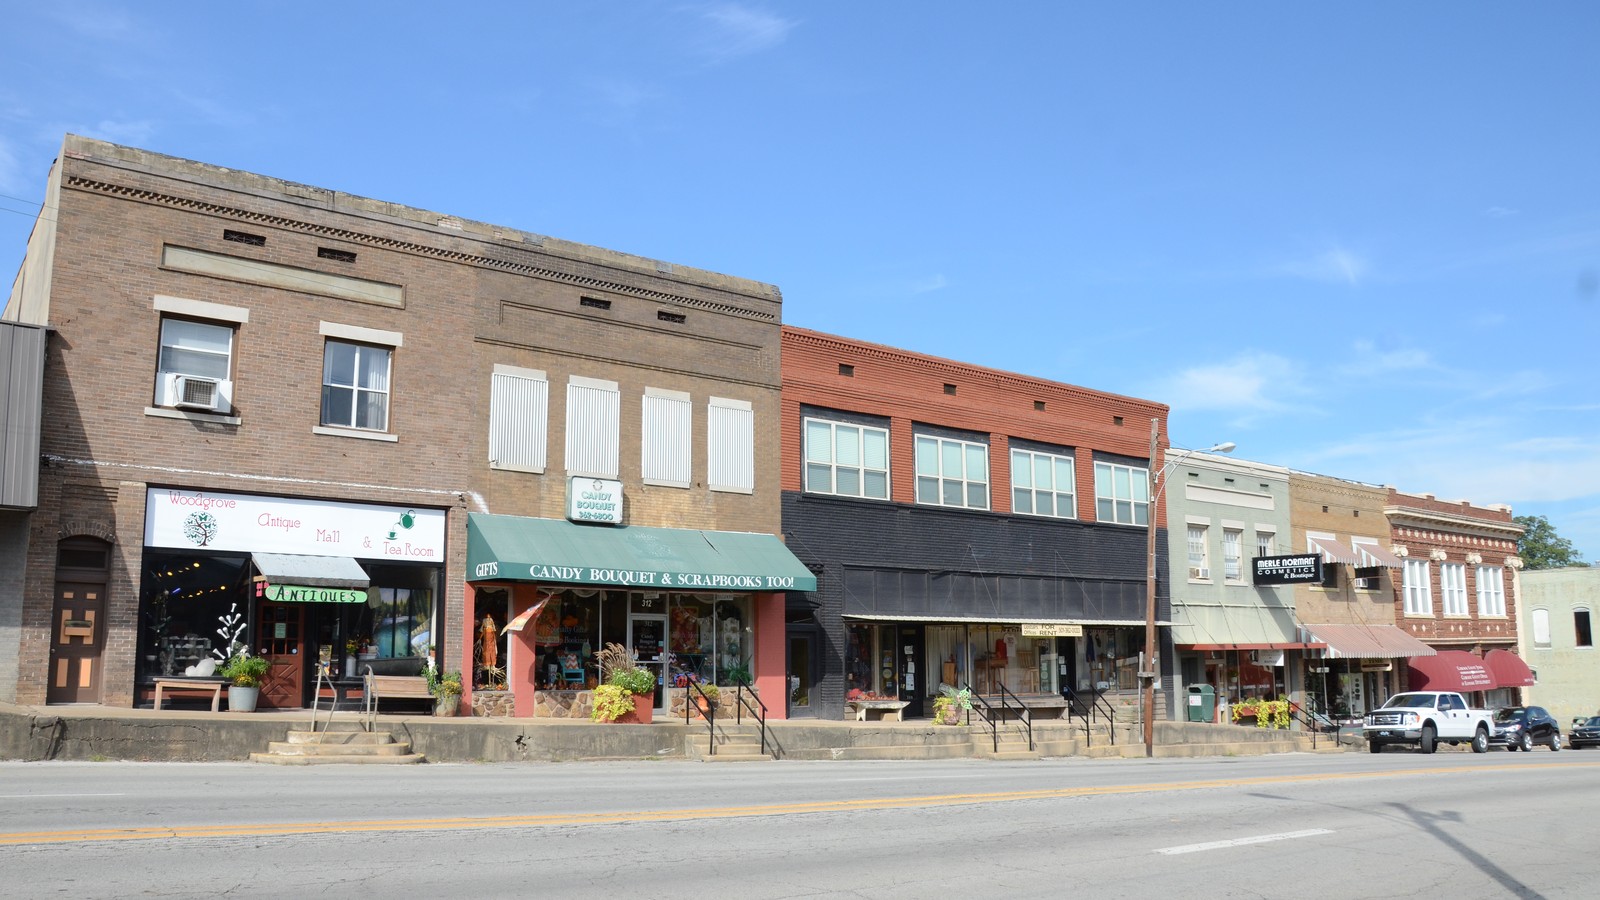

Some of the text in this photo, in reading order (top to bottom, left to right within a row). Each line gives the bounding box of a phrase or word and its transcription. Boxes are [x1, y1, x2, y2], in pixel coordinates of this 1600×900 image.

[169, 490, 236, 511] Woodgrove
[581, 491, 612, 502] CANDY
[577, 501, 616, 512] BOUQUET
[258, 513, 301, 532] Antique
[579, 511, 614, 521] 362-6800
[316, 529, 340, 544] Mall
[363, 536, 373, 550] &
[384, 542, 435, 557] Tea Room
[475, 561, 498, 577] GIFTS
[1257, 557, 1316, 569] MERLE NORMAN
[529, 564, 794, 588] CANDY BOUQUET & SCRAPBOOKS TOO!
[1257, 567, 1316, 576] COSMETICS
[1290, 572, 1315, 580] Boutique
[275, 586, 357, 602] ANTIQUES
[641, 599, 652, 608] 312
